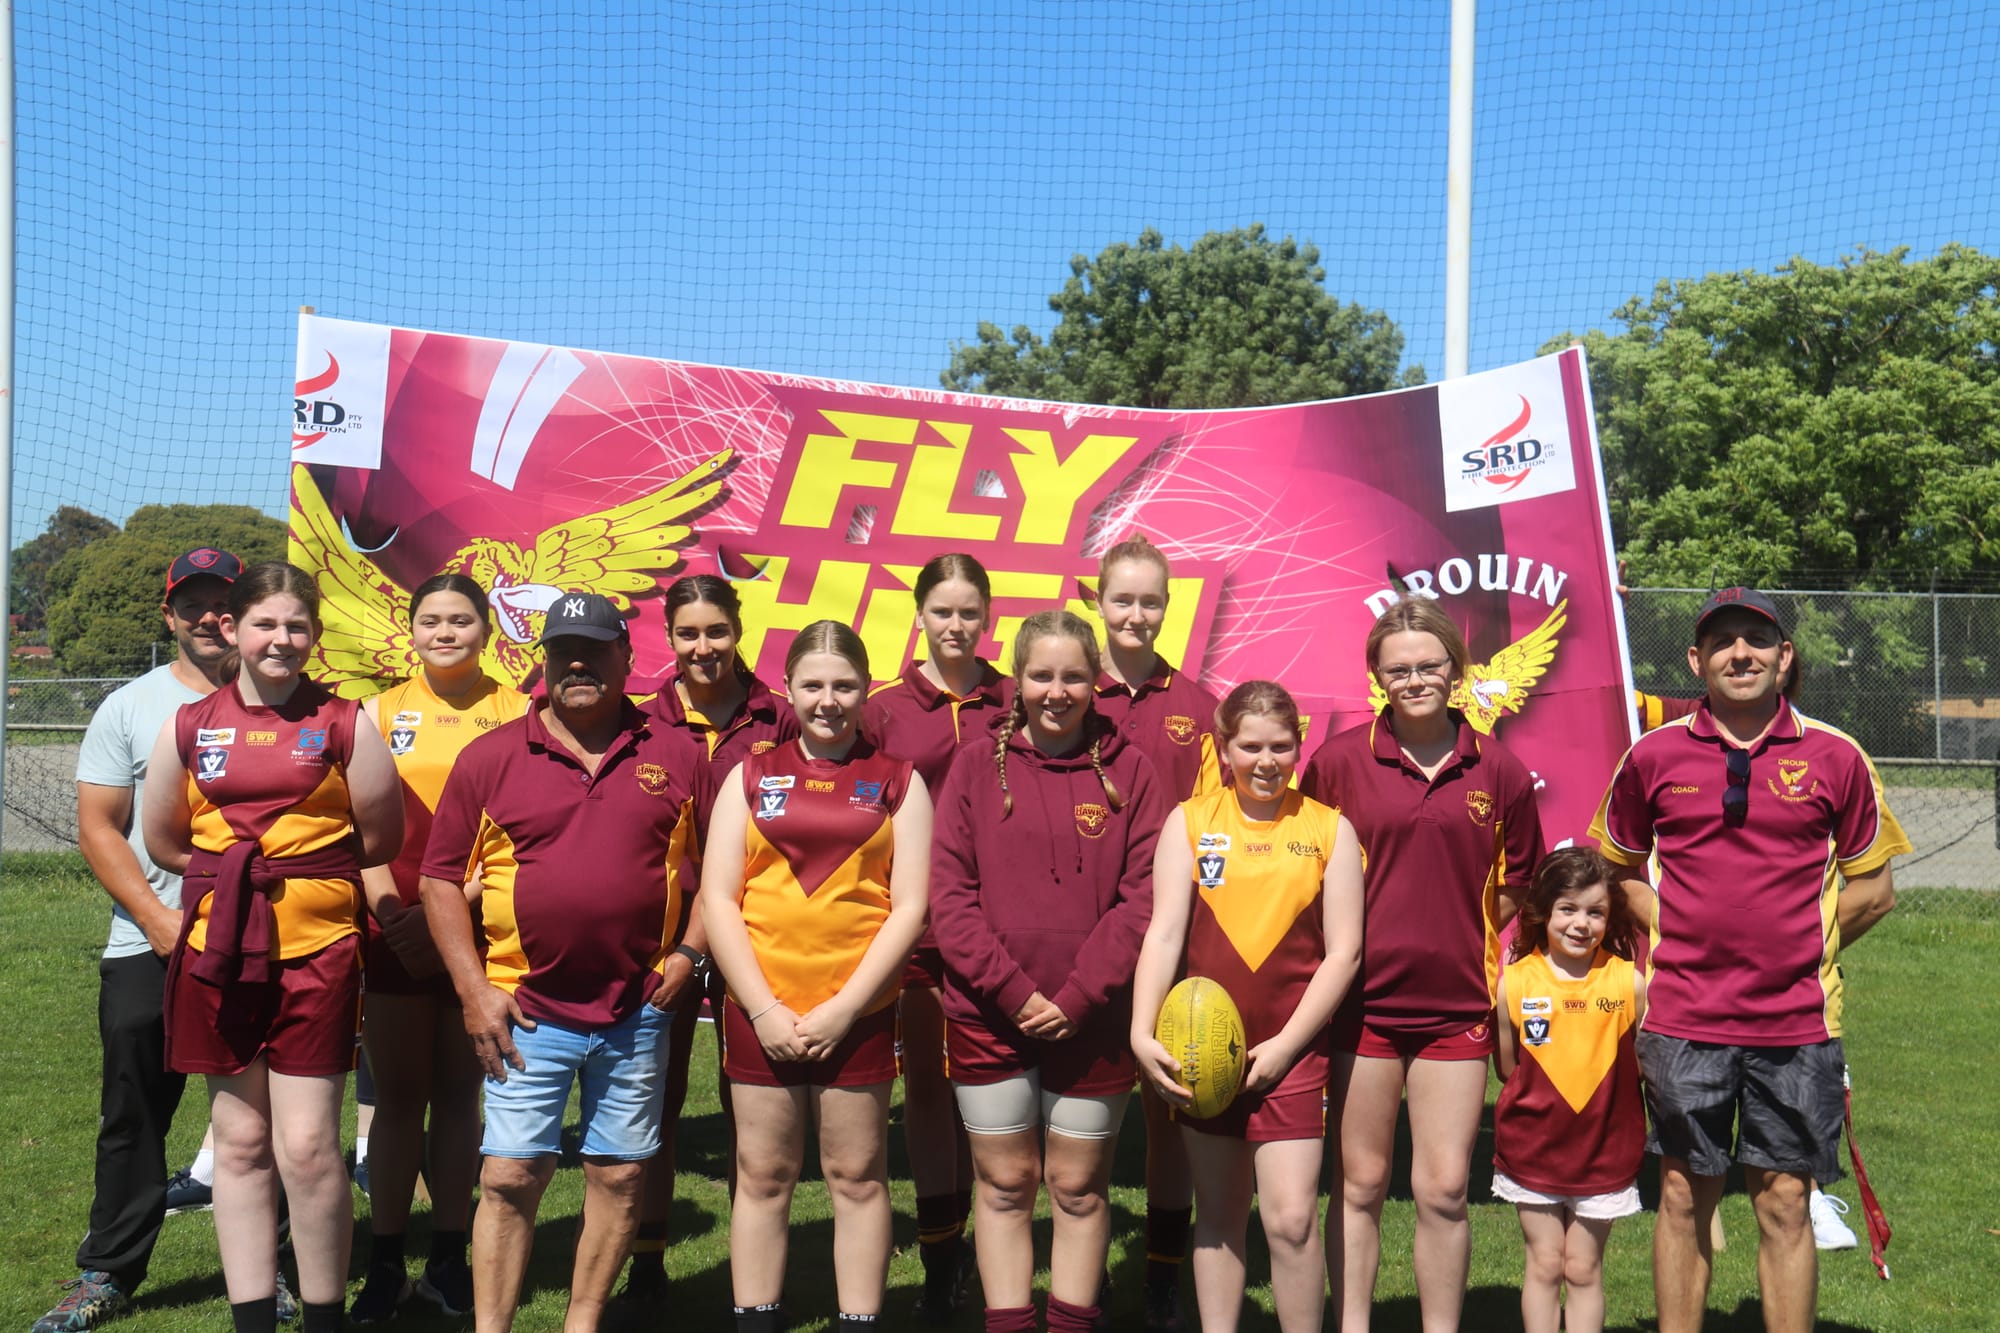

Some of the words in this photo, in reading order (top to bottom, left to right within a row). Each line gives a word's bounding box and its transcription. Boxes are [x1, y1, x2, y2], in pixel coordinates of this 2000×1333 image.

[348, 422, 362, 430] LTD
[1461, 439, 1542, 473] SRD
[1461, 472, 1485, 480] FIRE
[1487, 458, 1546, 475] PROTECTION
[779, 409, 1139, 545] FLY
[1363, 553, 1568, 620] DROUIN
[247, 732, 276, 741] SWD
[806, 780, 834, 789] SWD
[1671, 786, 1699, 794] COACH
[1246, 844, 1272, 853] SWD
[1564, 1001, 1586, 1009] SWD
